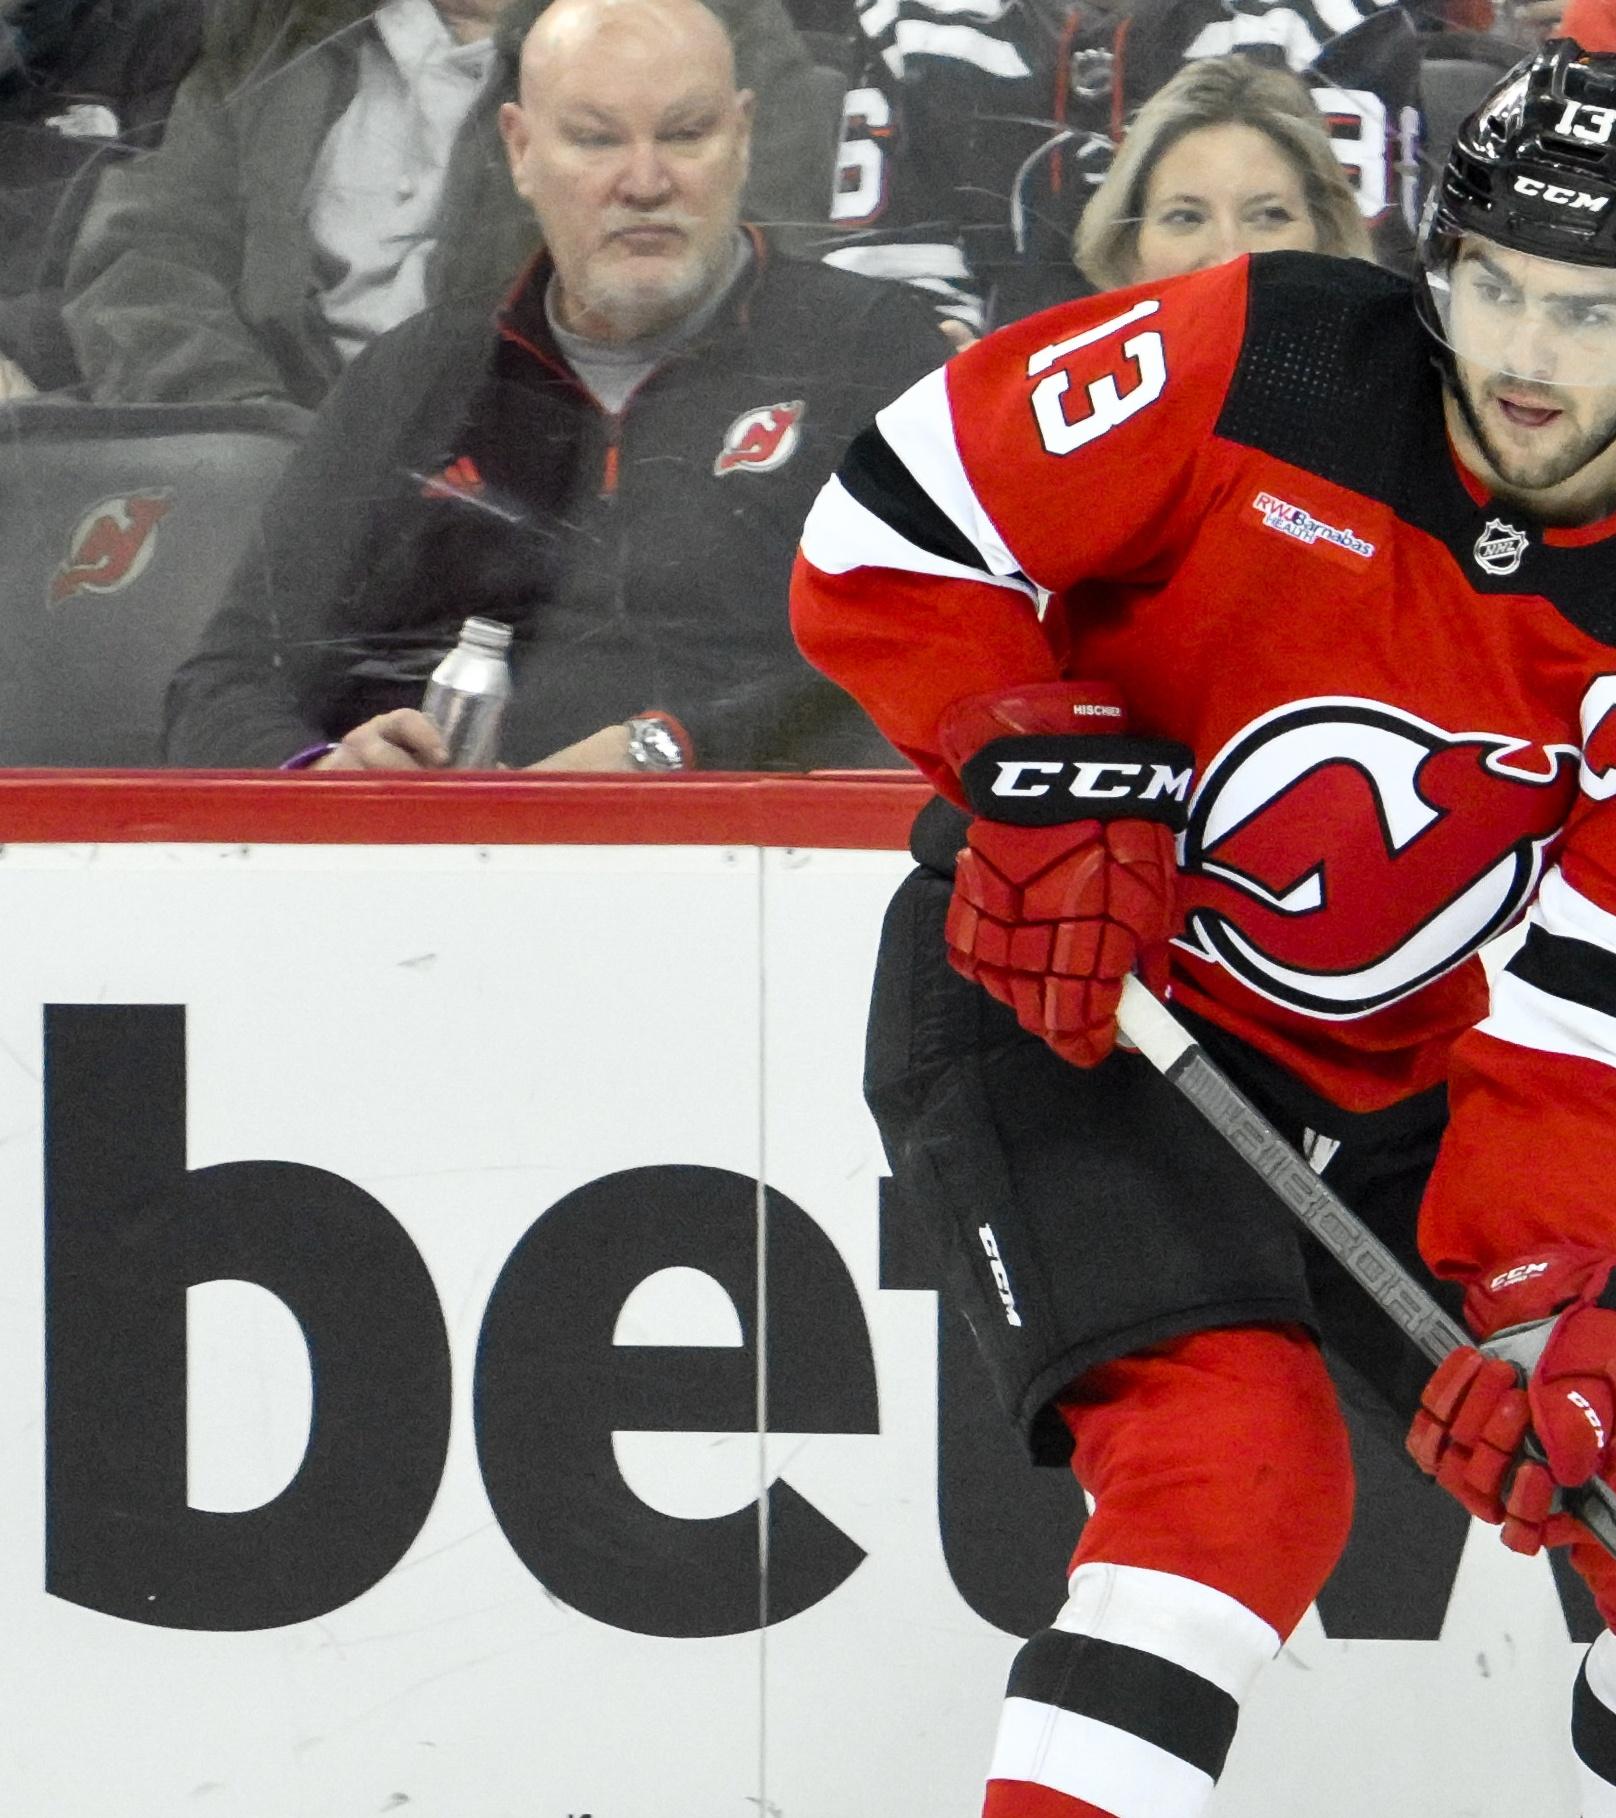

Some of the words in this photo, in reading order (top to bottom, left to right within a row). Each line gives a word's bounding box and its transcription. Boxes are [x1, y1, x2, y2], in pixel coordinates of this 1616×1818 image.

[1513, 175, 1610, 212] CCM
[1027, 299, 1168, 456] 13
[990, 761, 1193, 801] CCM
[978, 1222, 1022, 1327] CCM
[1490, 1262, 1549, 1289] CCM
